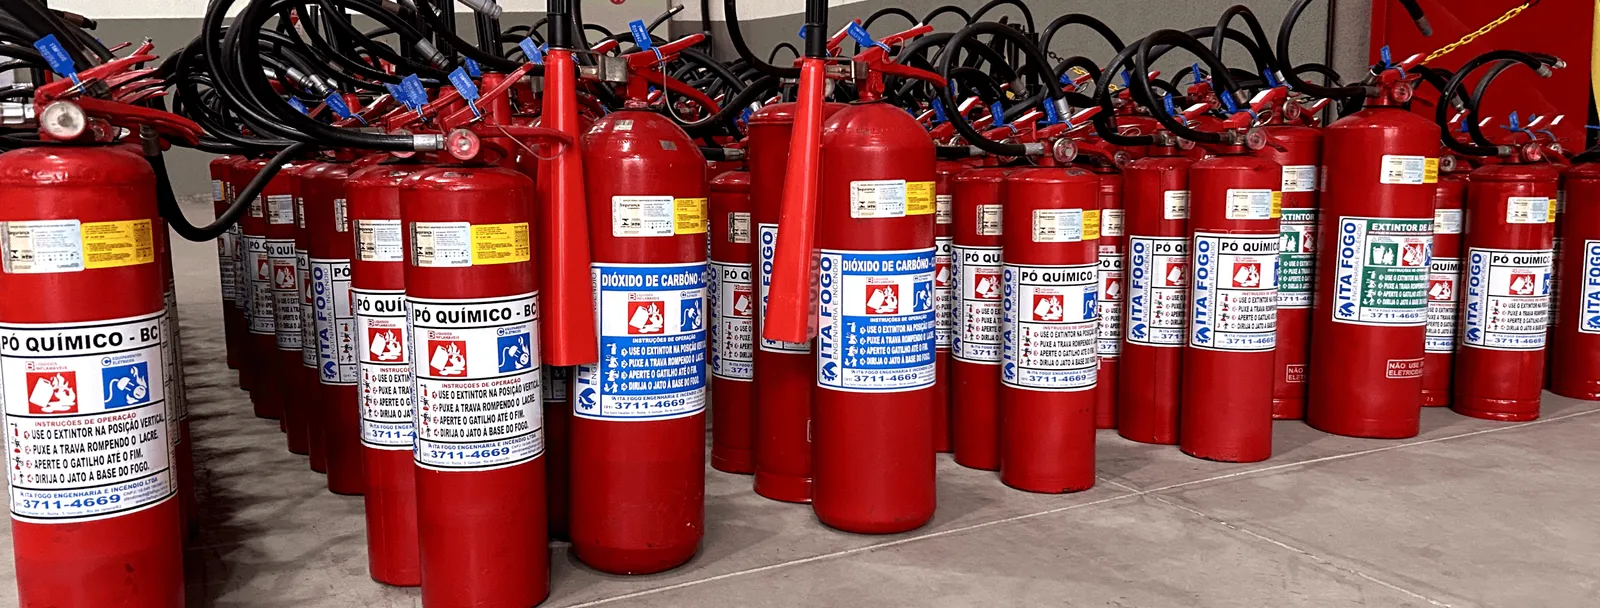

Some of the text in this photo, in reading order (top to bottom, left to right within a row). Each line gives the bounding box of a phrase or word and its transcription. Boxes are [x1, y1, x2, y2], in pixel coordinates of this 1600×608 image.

[1372, 223, 1418, 231] EXTINTOR
[276, 244, 294, 255] QUÍ
[1156, 242, 1171, 252] PÓ
[1222, 241, 1238, 251] PÓ
[763, 231, 773, 286] FOGO
[965, 251, 979, 262] PÓ
[1339, 223, 1356, 300] ITA FOGO
[1493, 254, 1508, 263] PÓ
[334, 265, 350, 277] PÓ
[843, 257, 928, 272] DIÓXIDO DE CARBÔNO
[602, 271, 697, 287] DIÓXIDO DE CARBÔNO
[725, 268, 737, 279] PÓ
[1022, 270, 1092, 282] PÓ QUÍMICO
[1132, 242, 1144, 321] ITA FOGO
[1196, 241, 1209, 324] ITA FOGO
[1467, 253, 1482, 325] ITA FOGO
[358, 297, 370, 311] PÓ
[821, 257, 832, 359] ITA FOGO
[1587, 293, 1600, 313] ITA
[313, 267, 330, 358] ITA FOGO
[414, 303, 536, 324] PÓ QUÍMICO BC
[2, 326, 158, 352] PÓ QUÍMICO BC
[328, 312, 336, 360] ENGENHARIA
[629, 345, 672, 355] USE EXTINTOR
[491, 378, 521, 386] OPERAÇÃO
[854, 373, 917, 382] 3711-4669
[438, 384, 522, 399] USE O EXTINTOR NA POSIÇÃO
[439, 398, 520, 412] PUXE A TRAVA ROMPENDO O
[615, 399, 685, 409] 3711-4669
[97, 412, 136, 423] OPERAÇÃO
[440, 410, 513, 425] APERTE O GATILHO ATÉ O
[32, 419, 139, 440] USE O EXTINTOR NA POSIÇÃO
[441, 429, 458, 437] DIRIJA
[460, 429, 464, 437] O
[466, 428, 481, 437] JATO
[489, 426, 504, 436] BASE
[506, 424, 513, 433] DO
[33, 430, 158, 454] PUXE A TRAVA ROMPENDO O LACRE.
[503, 437, 526, 445] INCÊNDIO
[34, 448, 143, 469] APERTE O GATILHO ATÉ O FIM.
[431, 447, 510, 459] 3711-4669
[35, 474, 57, 484] DIRIJA
[60, 474, 65, 483] O
[67, 472, 86, 483] JATO
[97, 468, 116, 480] BASE
[119, 466, 128, 476] DO
[130, 461, 149, 474] FOGO.
[54, 490, 103, 498] ENGENHARIA
[111, 482, 143, 492] INCÊNDIO
[23, 494, 120, 509] 3711-4669
